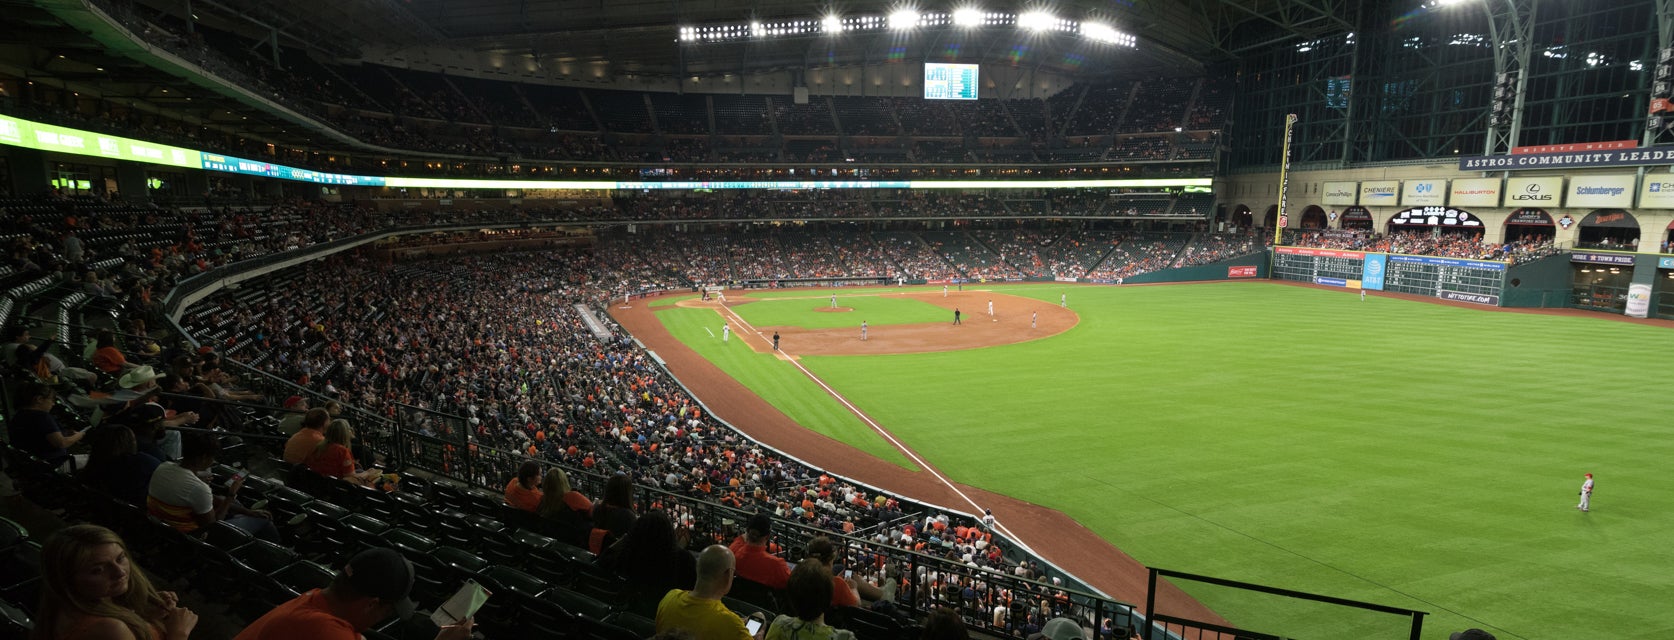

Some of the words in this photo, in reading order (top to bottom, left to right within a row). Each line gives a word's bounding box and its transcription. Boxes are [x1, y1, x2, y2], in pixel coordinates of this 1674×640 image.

[1466, 158, 1513, 167] ASTROS
[1519, 154, 1612, 165] COMMUNITY
[1576, 186, 1624, 196] Schlumberger
